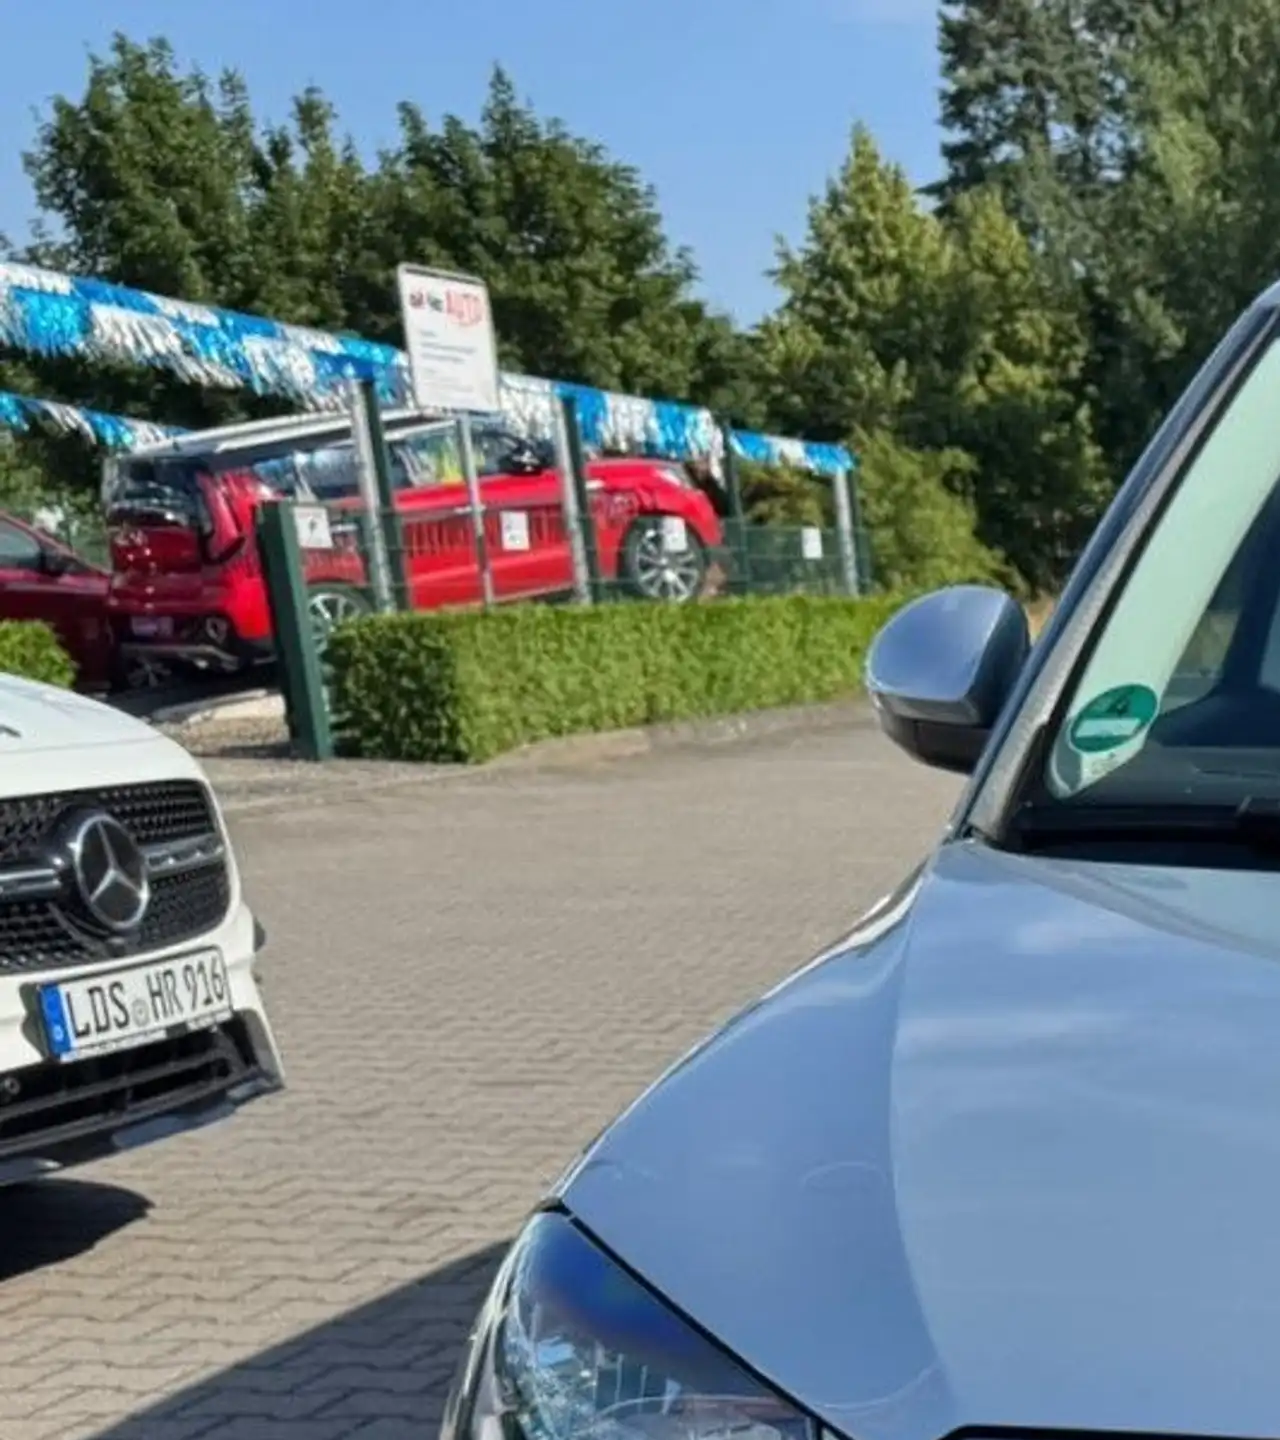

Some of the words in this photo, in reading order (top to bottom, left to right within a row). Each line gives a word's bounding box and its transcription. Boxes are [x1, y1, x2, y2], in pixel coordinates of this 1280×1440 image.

[66, 981, 130, 1038] LDS
[146, 969, 184, 1023] HR
[183, 957, 225, 1011] 916
